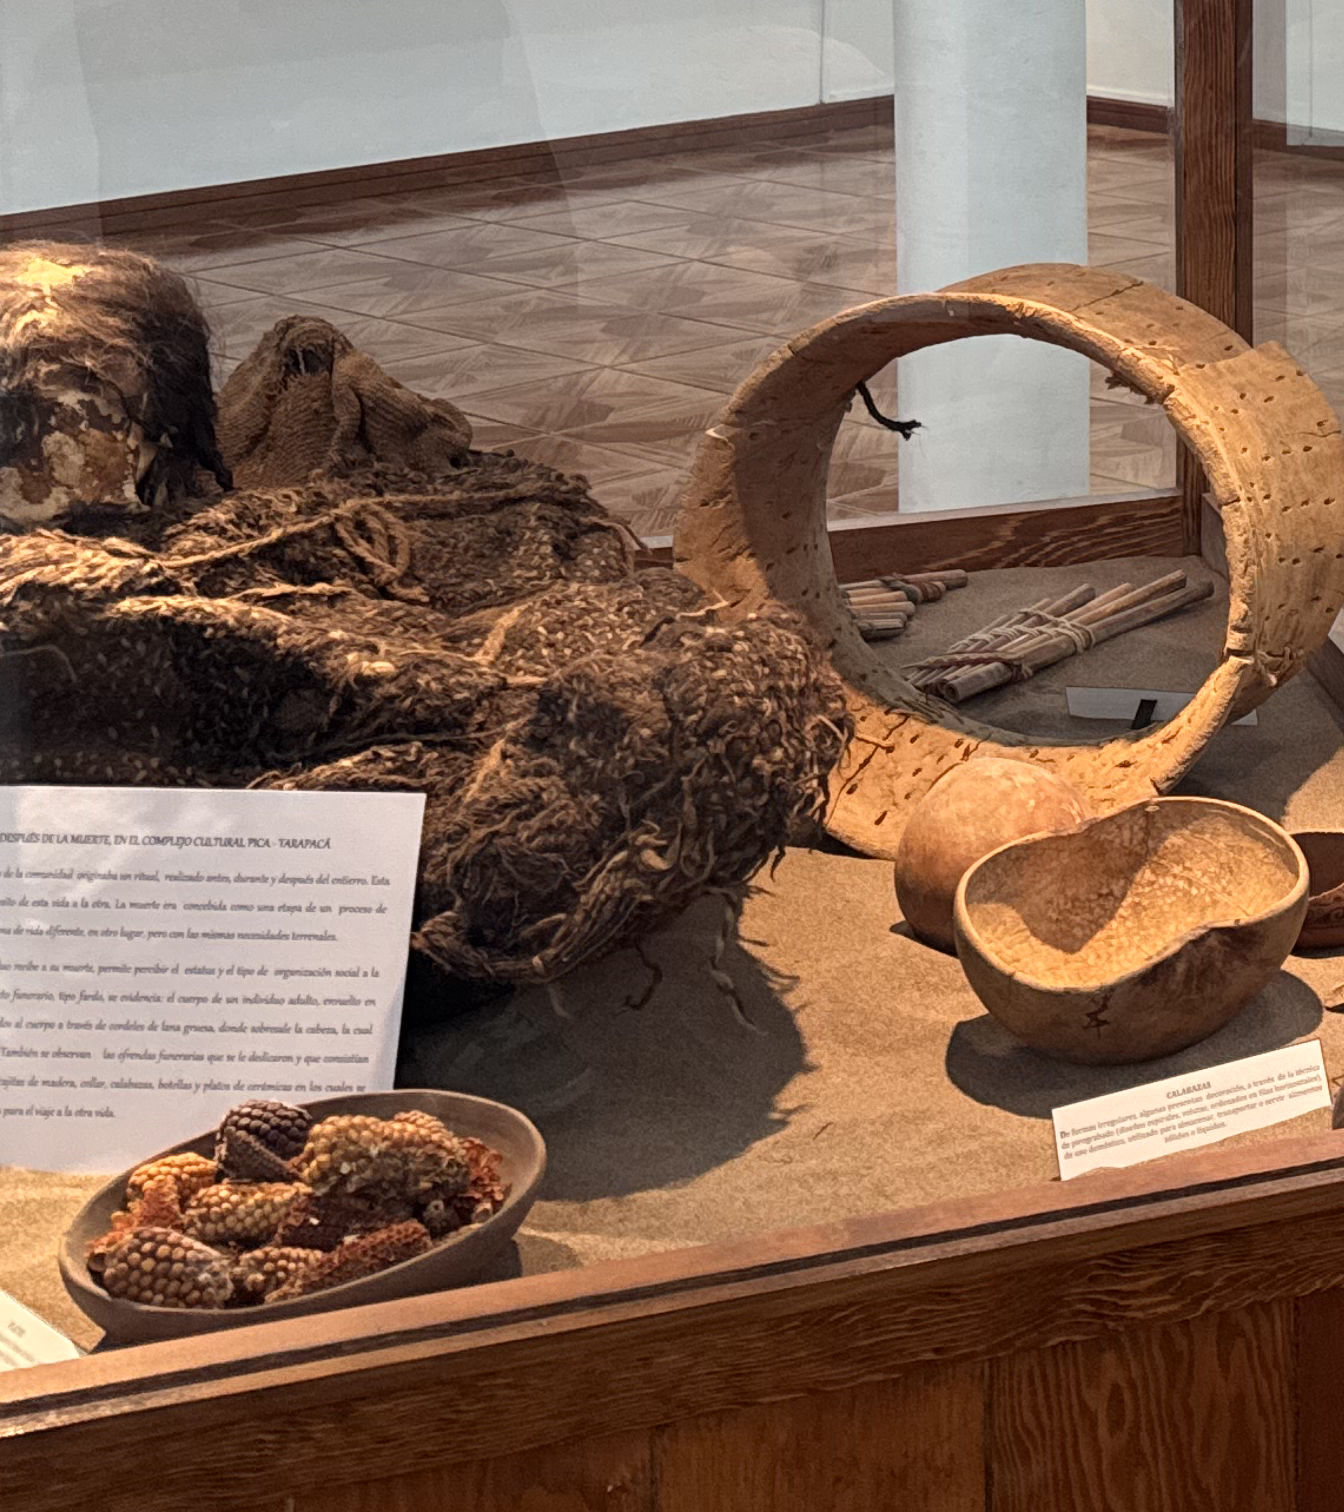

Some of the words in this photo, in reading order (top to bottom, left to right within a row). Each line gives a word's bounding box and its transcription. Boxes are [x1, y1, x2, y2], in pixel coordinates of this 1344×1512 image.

[42, 833, 55, 844] DE
[56, 833, 68, 845] LA
[193, 836, 245, 847] CULTURAL
[247, 837, 270, 848] PICA
[278, 837, 332, 849] TARAPACÁ
[1166, 1081, 1211, 1098] CALABAZAS
